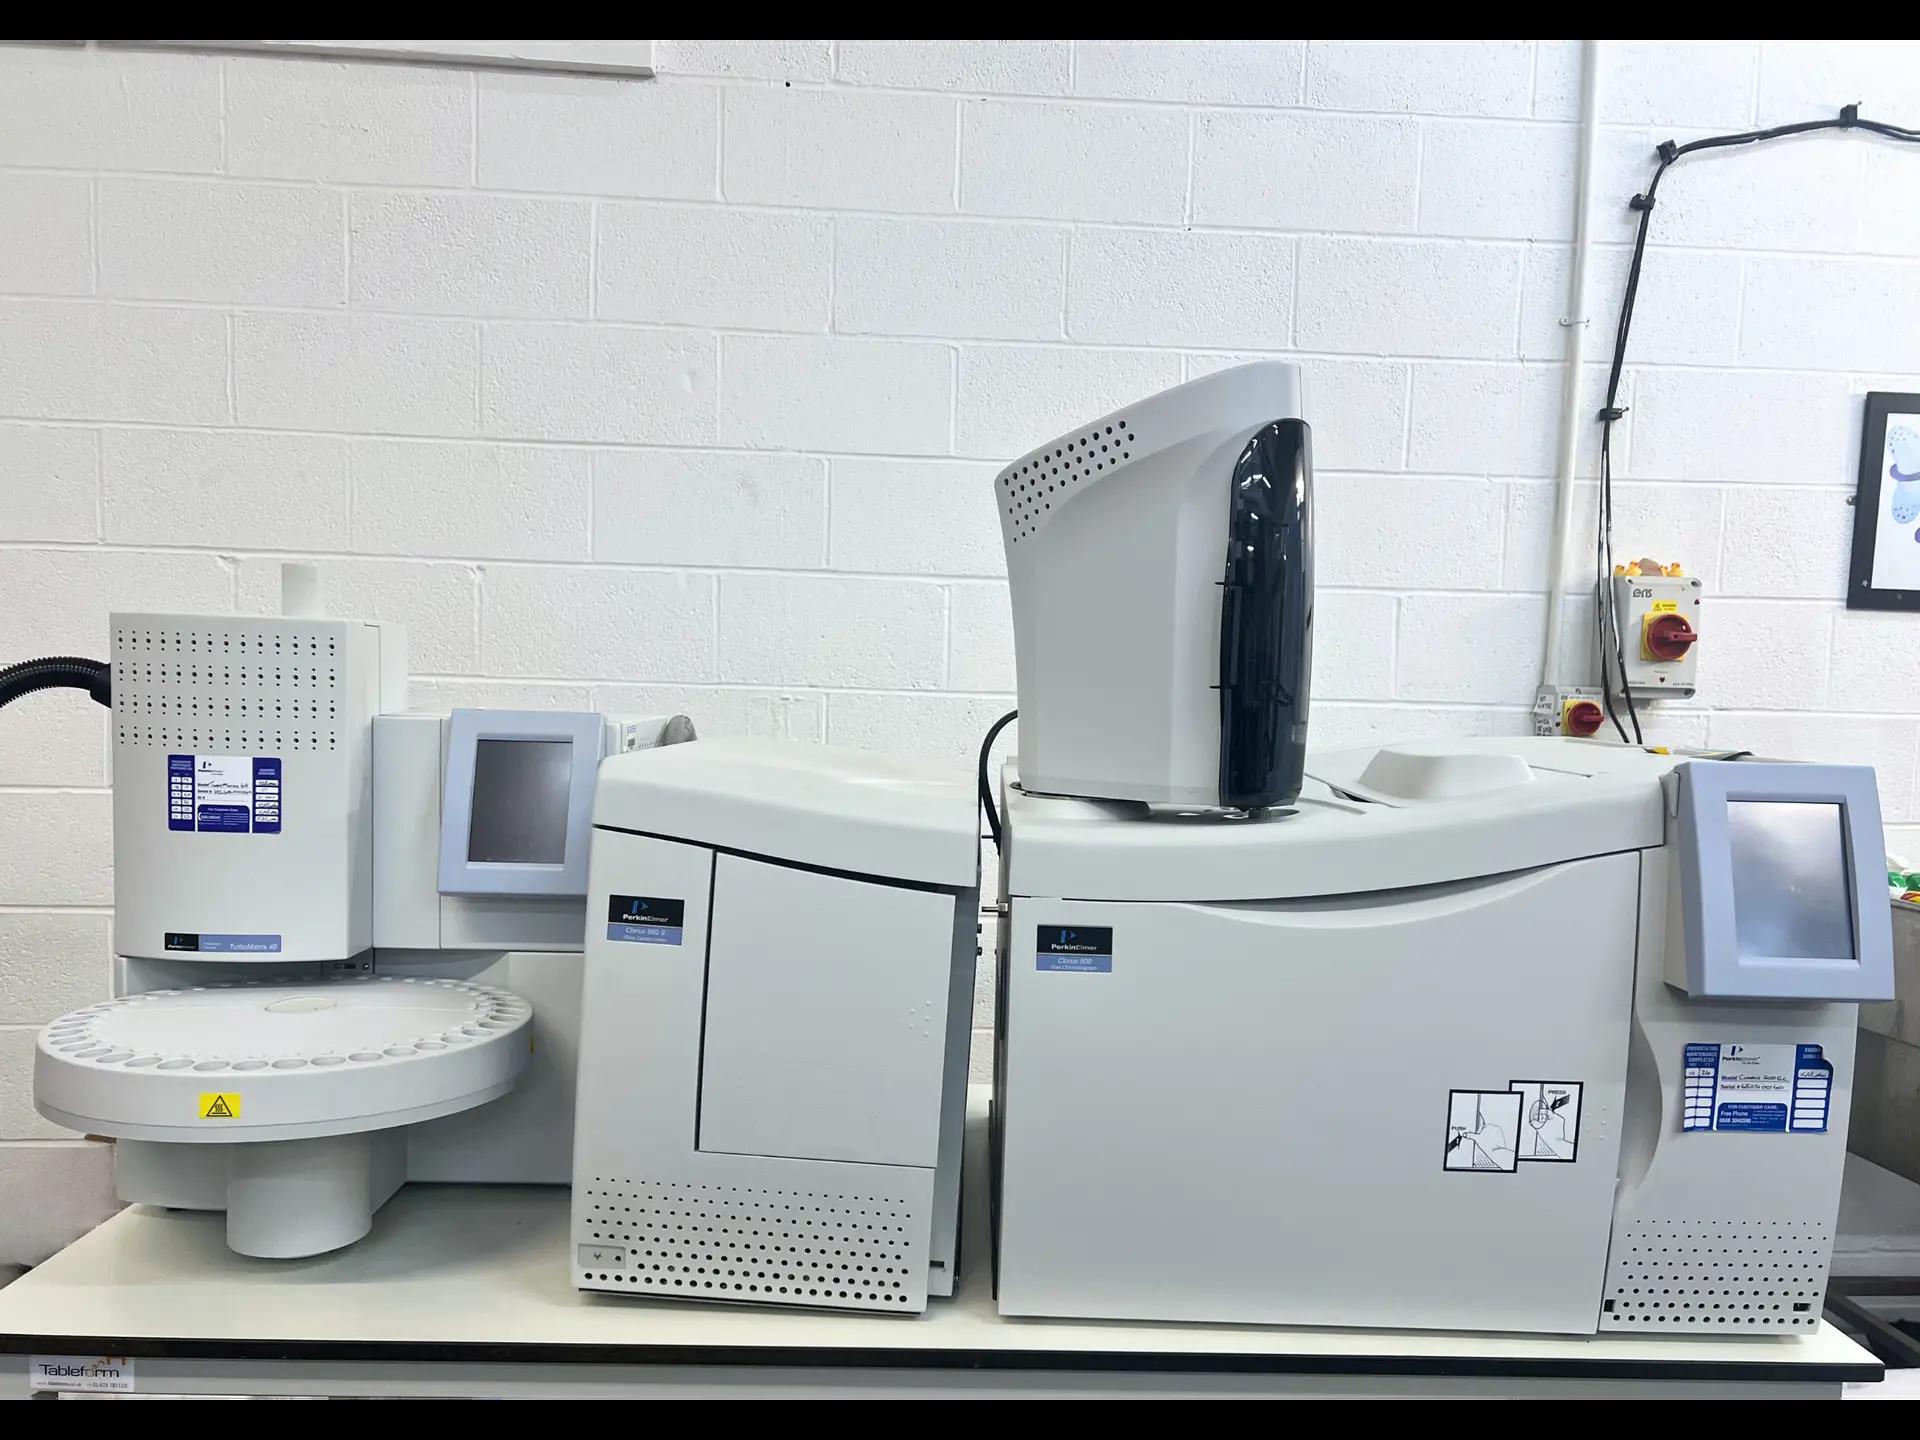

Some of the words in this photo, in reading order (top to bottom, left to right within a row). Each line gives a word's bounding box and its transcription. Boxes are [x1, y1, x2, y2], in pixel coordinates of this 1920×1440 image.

[622, 913, 669, 922] PerkinElmer
[1051, 943, 1097, 951] PerkinElmer
[38, 1363, 120, 1378] Tableform
